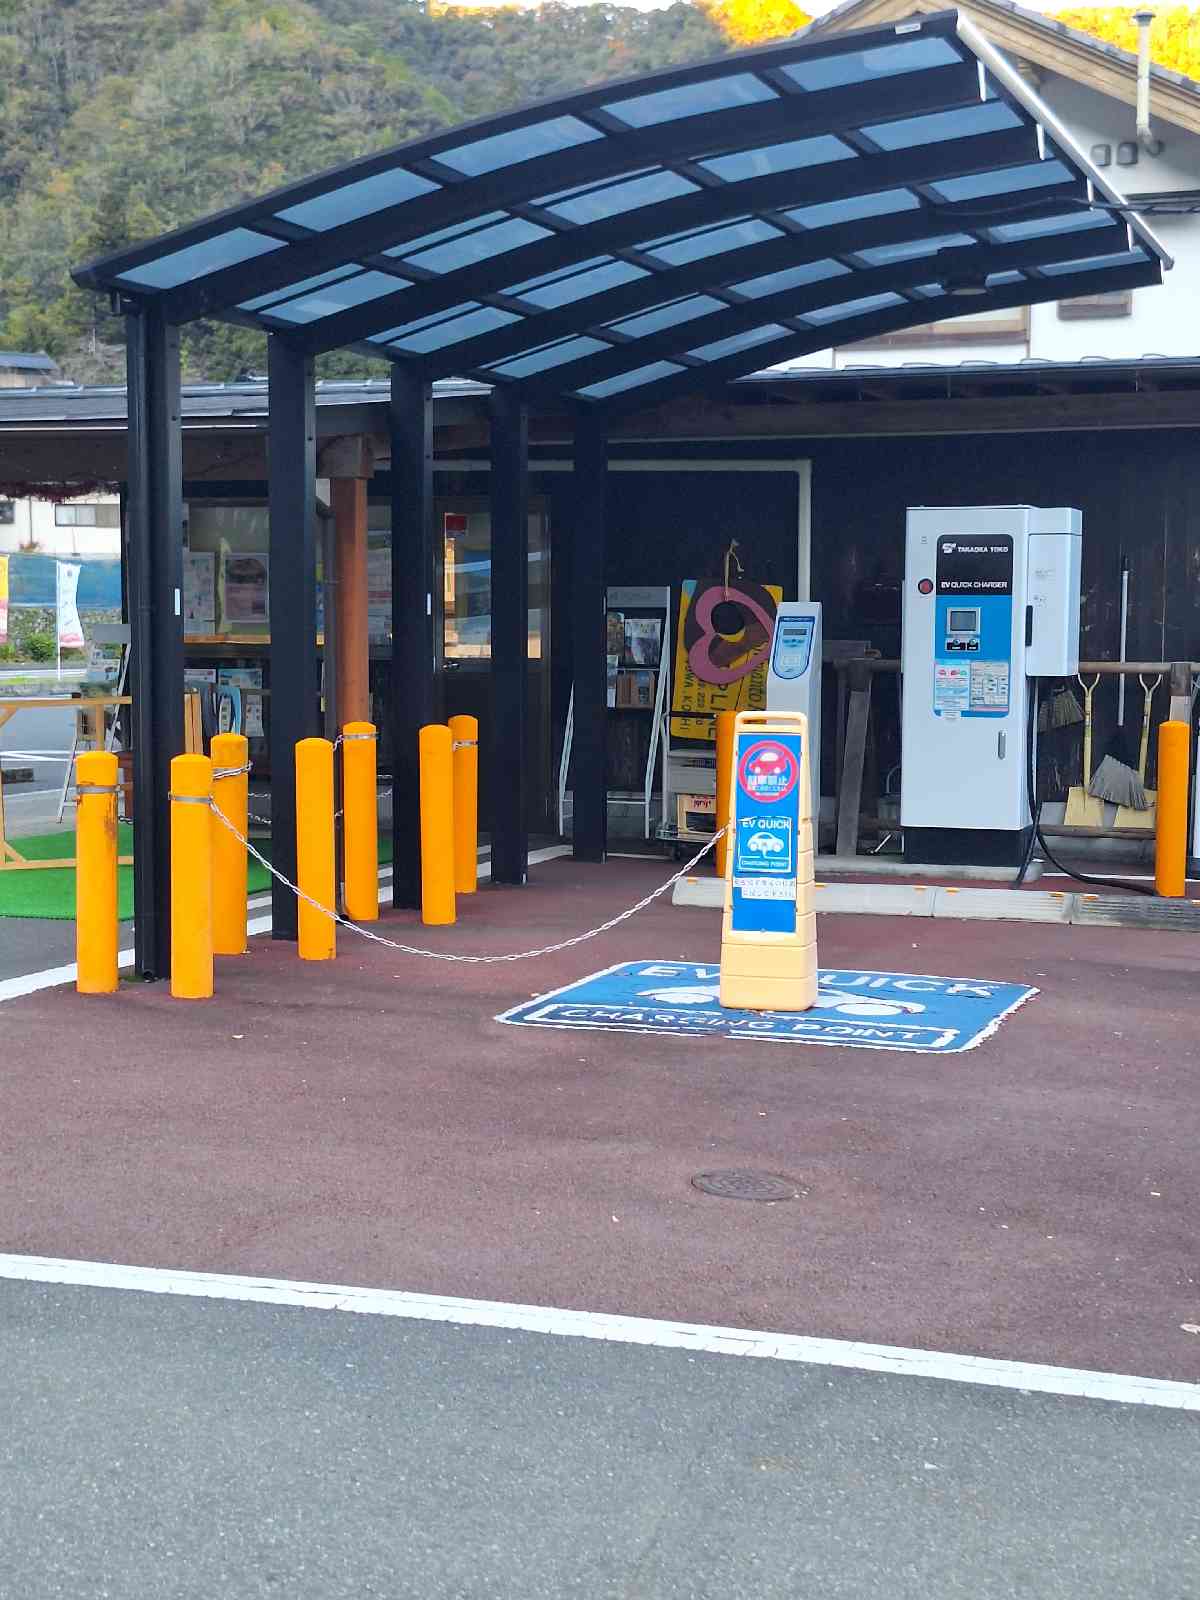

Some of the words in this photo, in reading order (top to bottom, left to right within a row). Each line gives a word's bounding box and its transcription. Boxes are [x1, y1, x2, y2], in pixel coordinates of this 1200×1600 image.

[941, 581, 951, 589] EV
[951, 581, 972, 589] QUICK
[973, 581, 1008, 589] CHARGER
[758, 819, 790, 830] QUICK
[817, 974, 1001, 998] UICK
[560, 1008, 775, 1029] CHARGING
[791, 1022, 922, 1040] POINT
